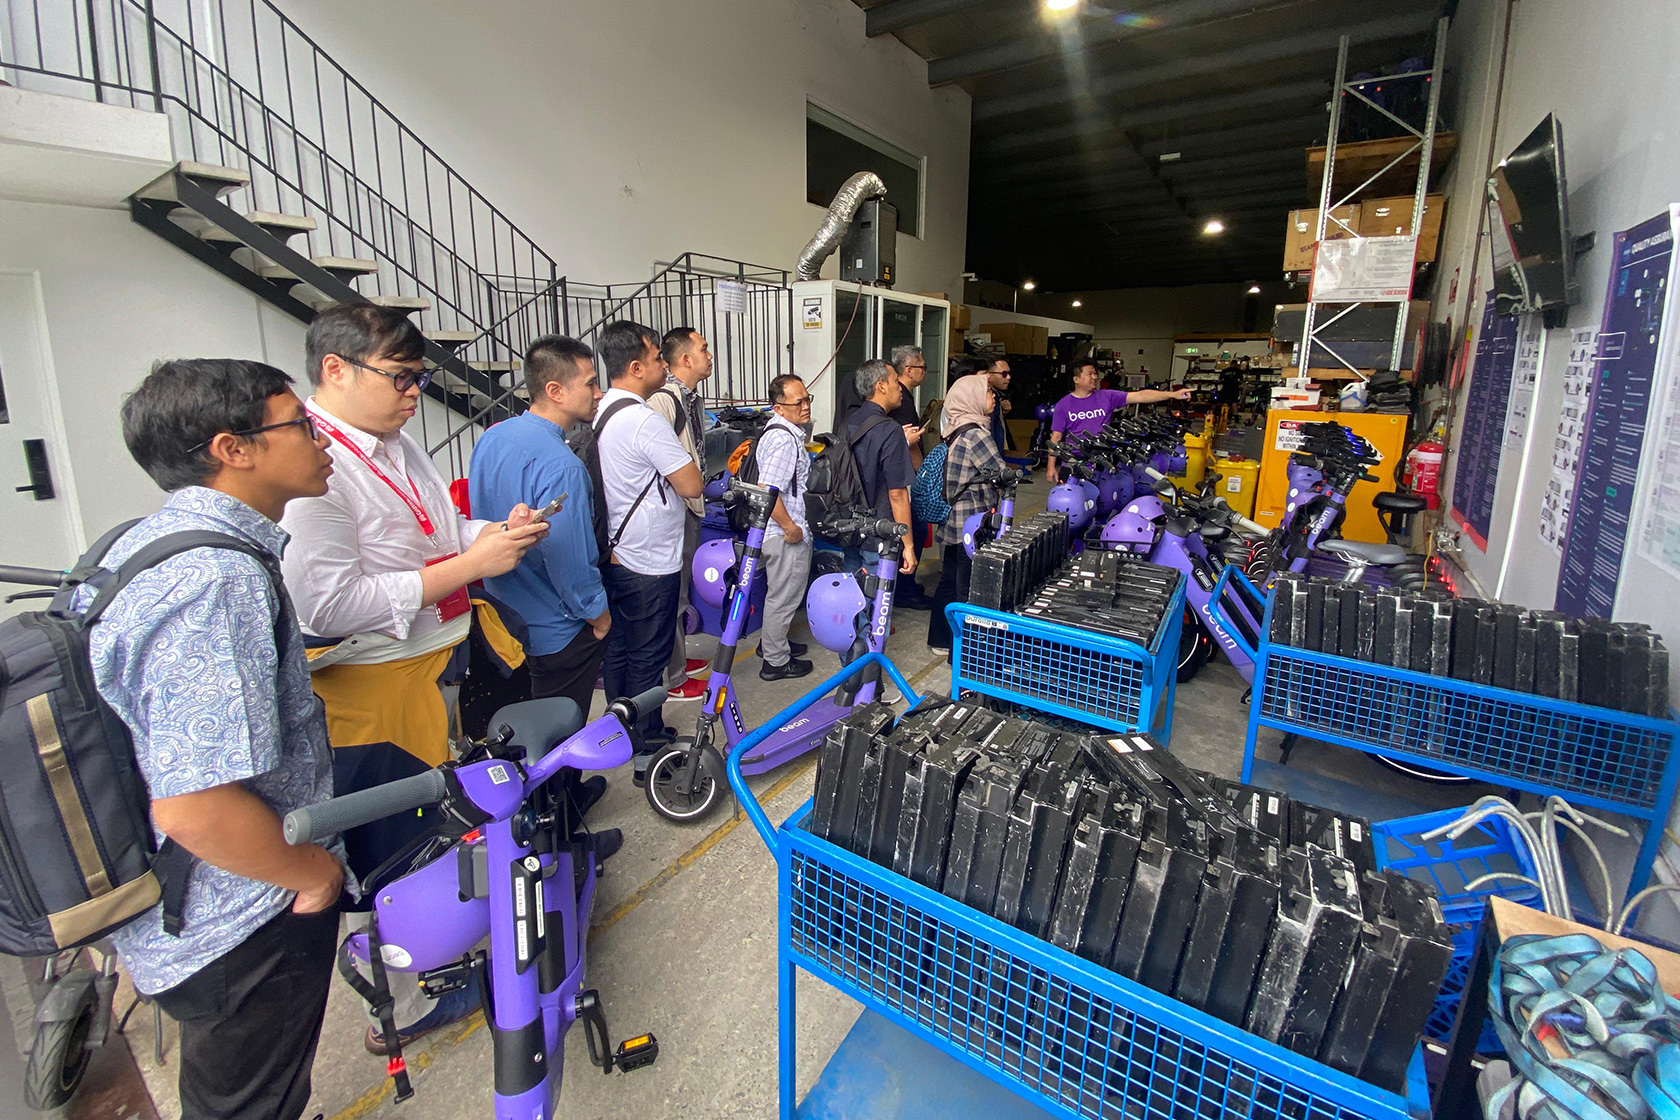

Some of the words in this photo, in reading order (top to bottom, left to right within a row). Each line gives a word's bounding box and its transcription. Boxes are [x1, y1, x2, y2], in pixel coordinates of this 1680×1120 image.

[1068, 408, 1106, 421] beam
[1311, 510, 1331, 535] beam
[739, 557, 754, 587] beam
[872, 592, 891, 636] beam
[779, 717, 810, 732] beam
